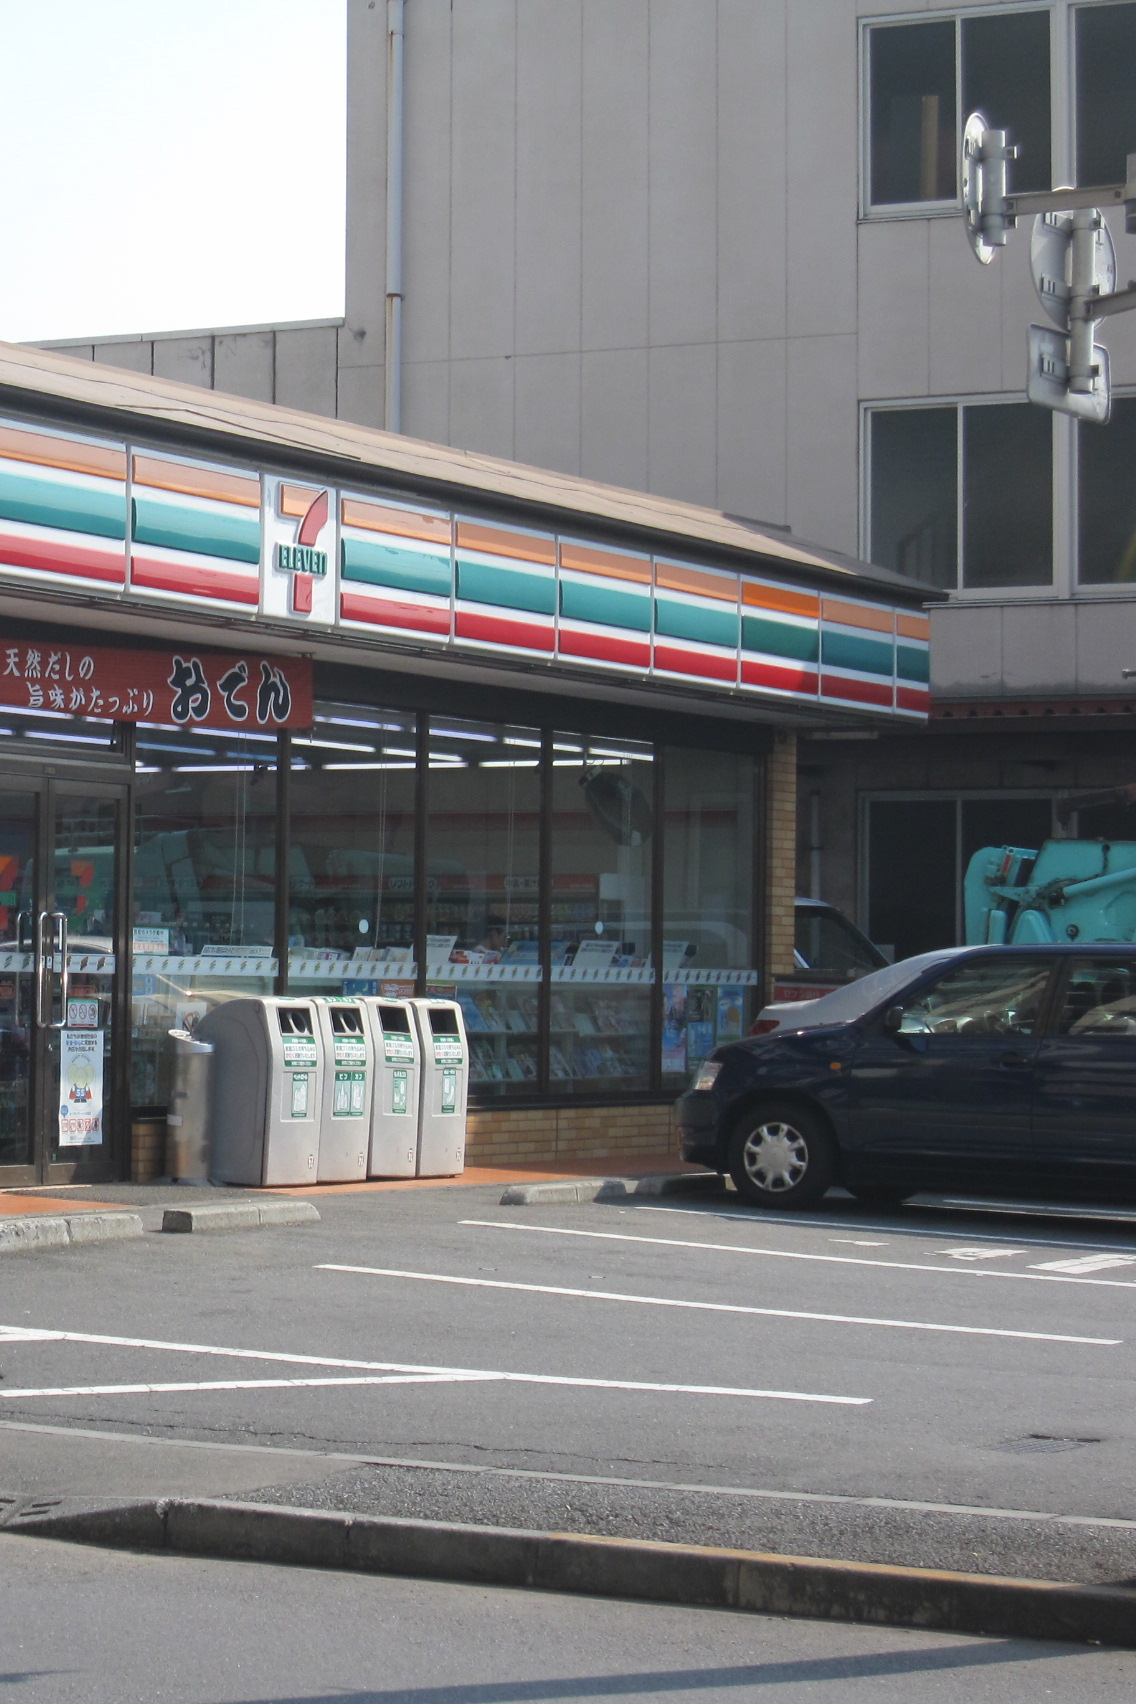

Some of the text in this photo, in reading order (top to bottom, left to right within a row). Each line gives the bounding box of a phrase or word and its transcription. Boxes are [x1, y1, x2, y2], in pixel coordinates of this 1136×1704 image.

[2, 648, 95, 681] 天然だしの
[25, 681, 155, 716] 旨味がたっぷり
[166, 654, 292, 725] おでん
